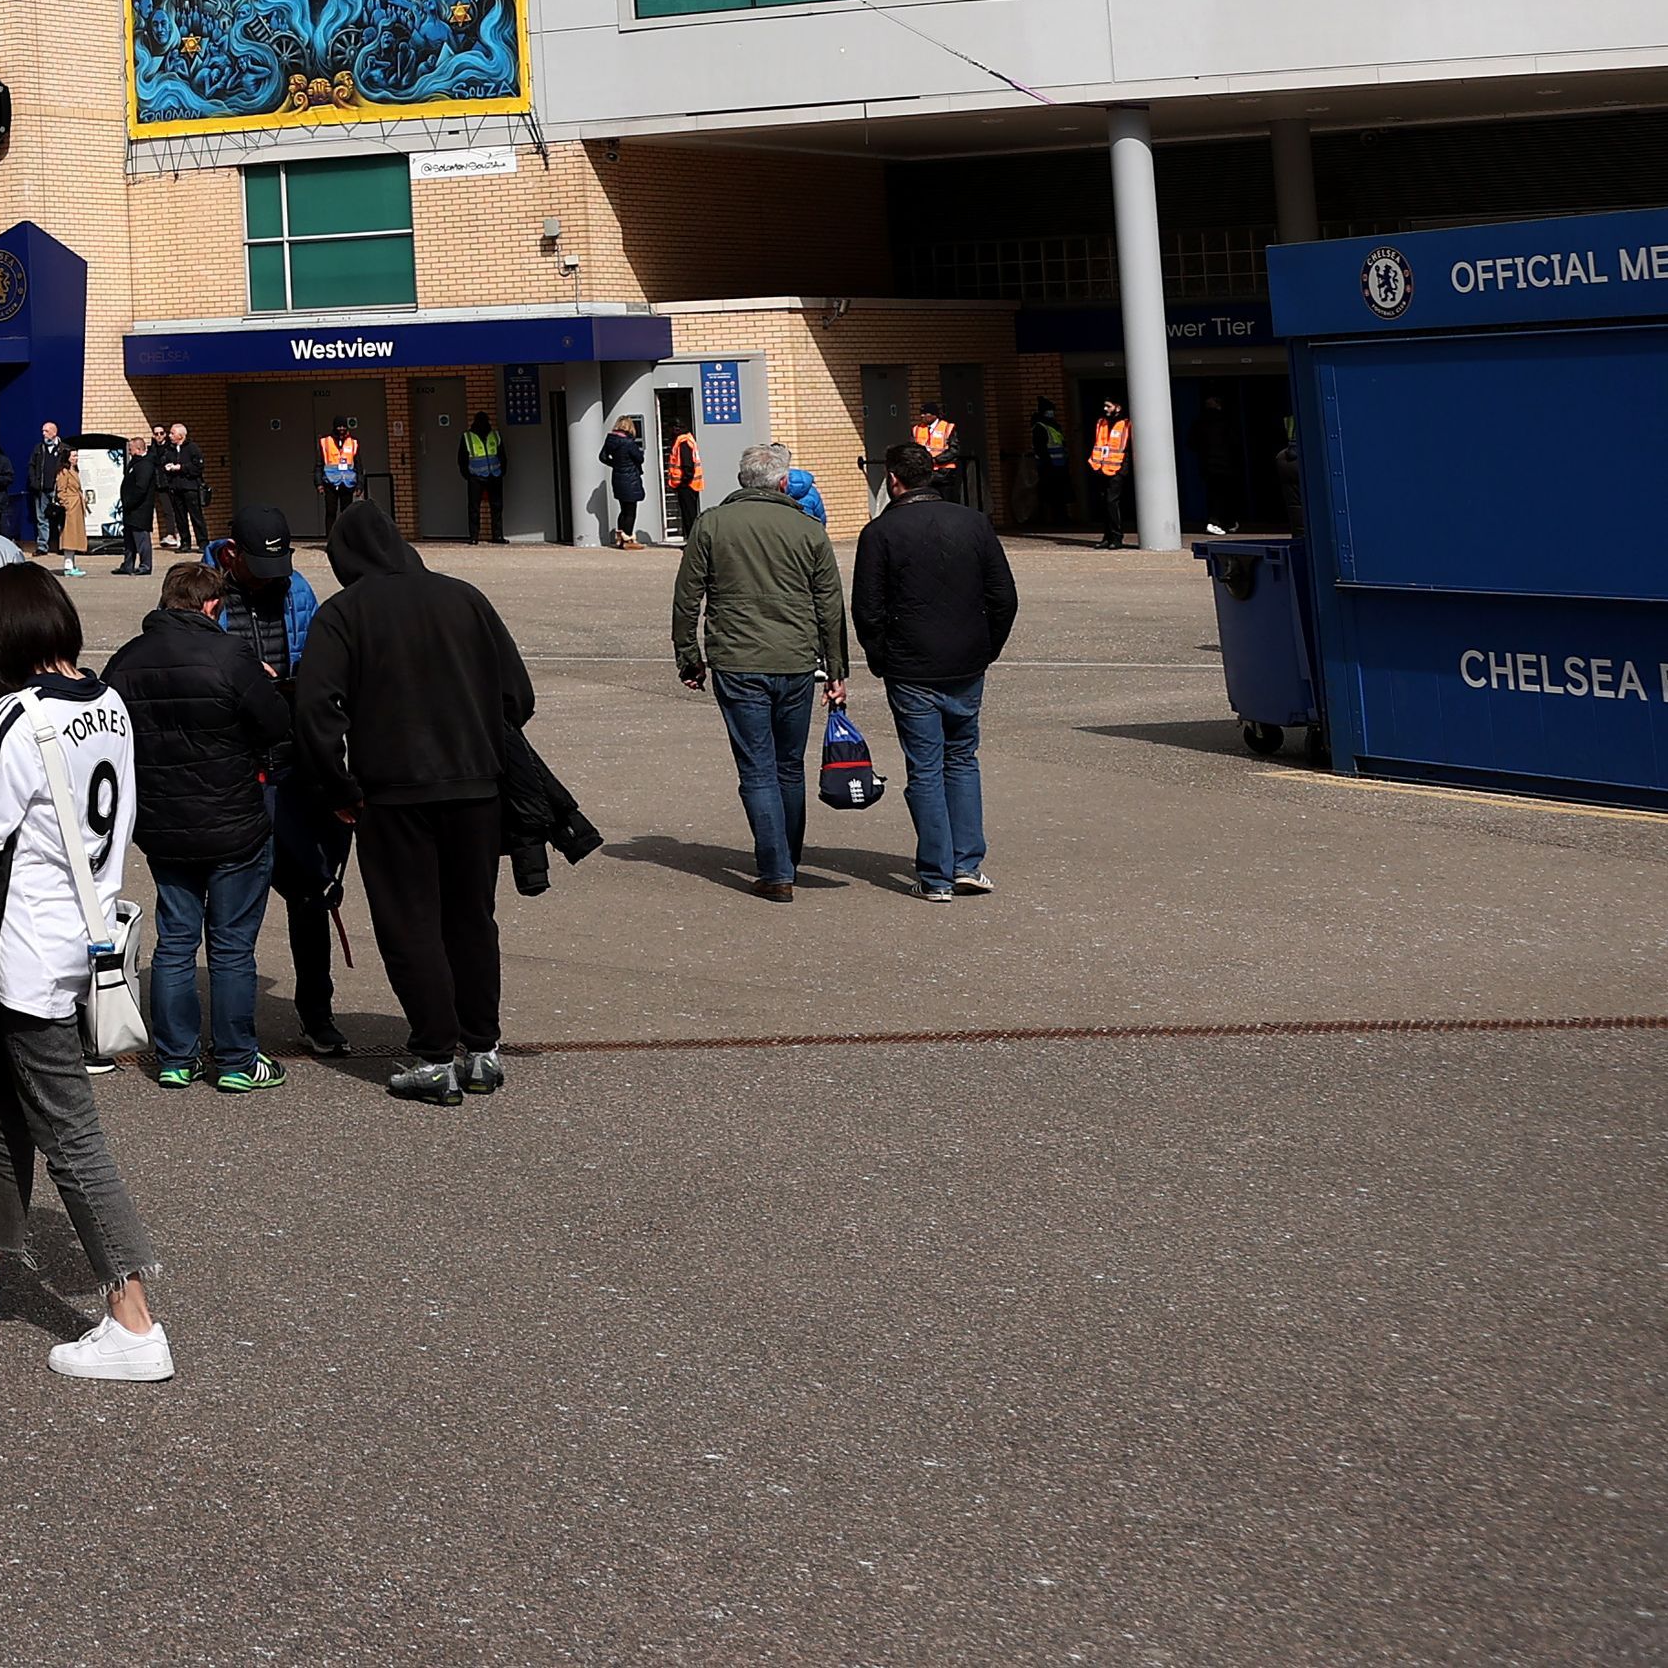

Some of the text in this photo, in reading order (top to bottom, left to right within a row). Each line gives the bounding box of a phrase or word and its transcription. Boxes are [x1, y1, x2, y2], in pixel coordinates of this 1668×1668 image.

[452, 81, 517, 99] SOUZA
[1366, 249, 1401, 266] CHELSEA
[1450, 245, 1668, 294] OFFICIAL ME
[1167, 317, 1256, 337] wer Tier
[290, 337, 394, 360] Westview
[1460, 649, 1648, 701] CHELSEA
[63, 708, 126, 748] TORRES
[86, 757, 119, 876] 9
